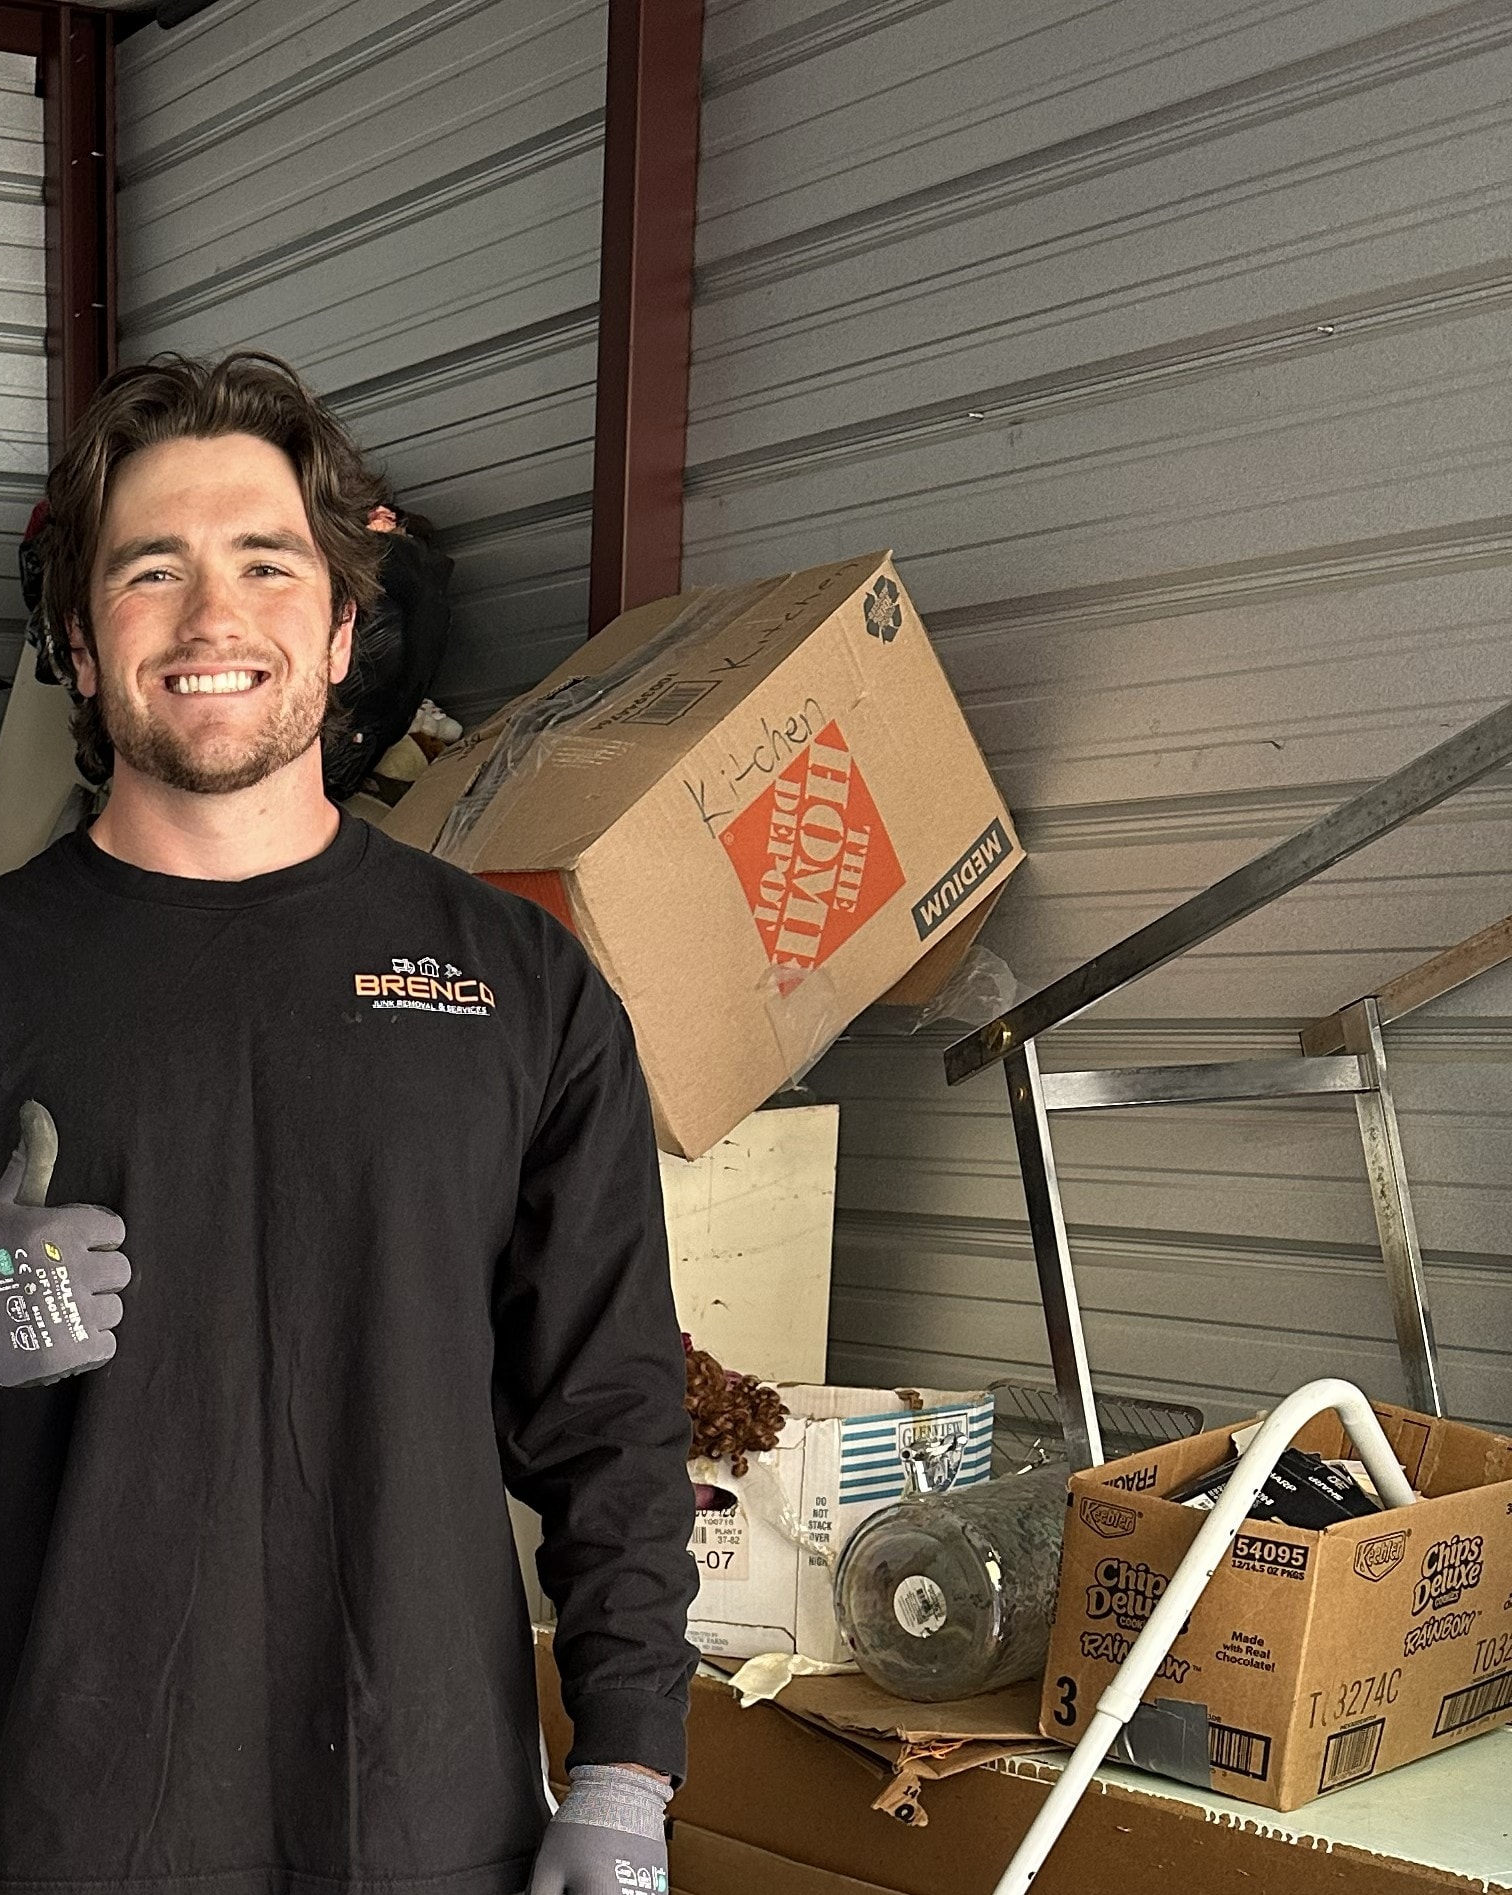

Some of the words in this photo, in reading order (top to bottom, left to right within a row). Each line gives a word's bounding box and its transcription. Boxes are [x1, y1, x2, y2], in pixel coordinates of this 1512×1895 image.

[683, 698, 826, 839] Kitchen
[752, 775, 802, 932] DEPOT
[772, 742, 851, 971] HOME
[833, 825, 871, 913] THE
[920, 830, 1002, 926] MEDIUM
[355, 974, 495, 1008] BRENCO
[1101, 1465, 1158, 1492] FRAG
[1270, 1472, 1297, 1493] HARP
[812, 1509, 829, 1518] NOT
[815, 1496, 827, 1506] DO
[1081, 1498, 1136, 1531] Keebler
[808, 1521, 832, 1530] STACK
[809, 1533, 830, 1543] OVER
[697, 1551, 735, 1570] -07
[1235, 1537, 1306, 1566] 54095
[1357, 1538, 1404, 1572] Keebler
[1421, 1535, 1483, 1578] Chips
[1095, 1557, 1172, 1598] Chip
[1267, 1565, 1279, 1576] OZ
[1086, 1583, 1160, 1619] Delu
[1412, 1560, 1484, 1616] Deluxe
[1223, 1642, 1243, 1653] with
[1245, 1646, 1270, 1659] Real
[1231, 1631, 1264, 1647] Made
[1054, 1676, 1078, 1727] 3
